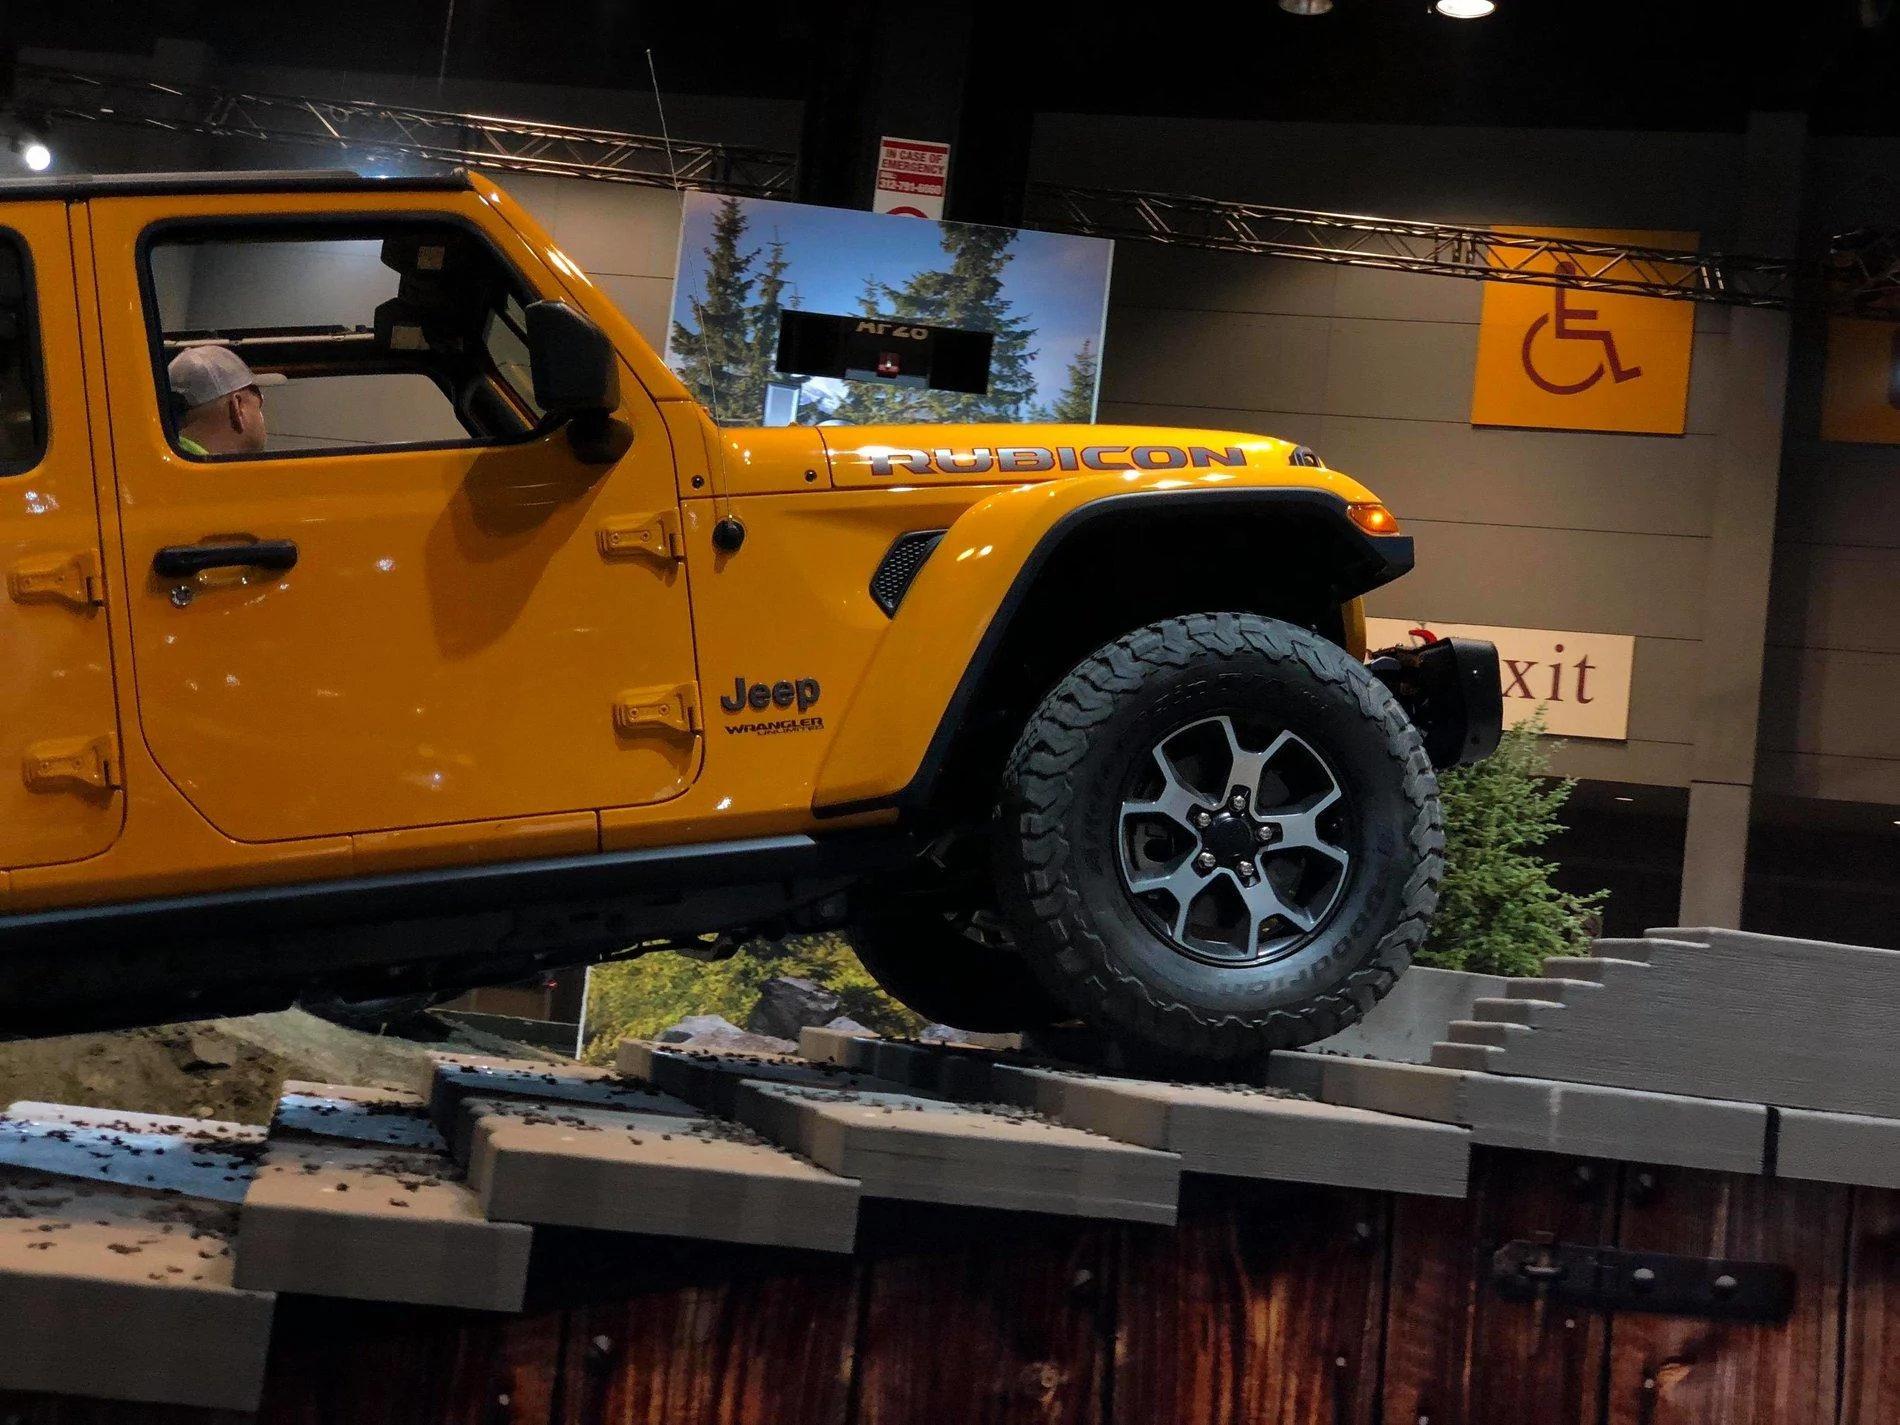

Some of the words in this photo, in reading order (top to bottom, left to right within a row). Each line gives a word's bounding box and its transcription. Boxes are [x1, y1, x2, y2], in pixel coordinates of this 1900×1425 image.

[886, 148, 897, 159] IN
[900, 150, 927, 162] CASE
[929, 154, 943, 164] OF
[881, 159, 945, 174] EMERGENCY
[868, 445, 1248, 476] RUBICON
[1501, 643, 1597, 704] xit
[720, 676, 821, 715] Jeep
[725, 717, 823, 735] WRANGLER
[757, 724, 825, 736] UNLIMITED
